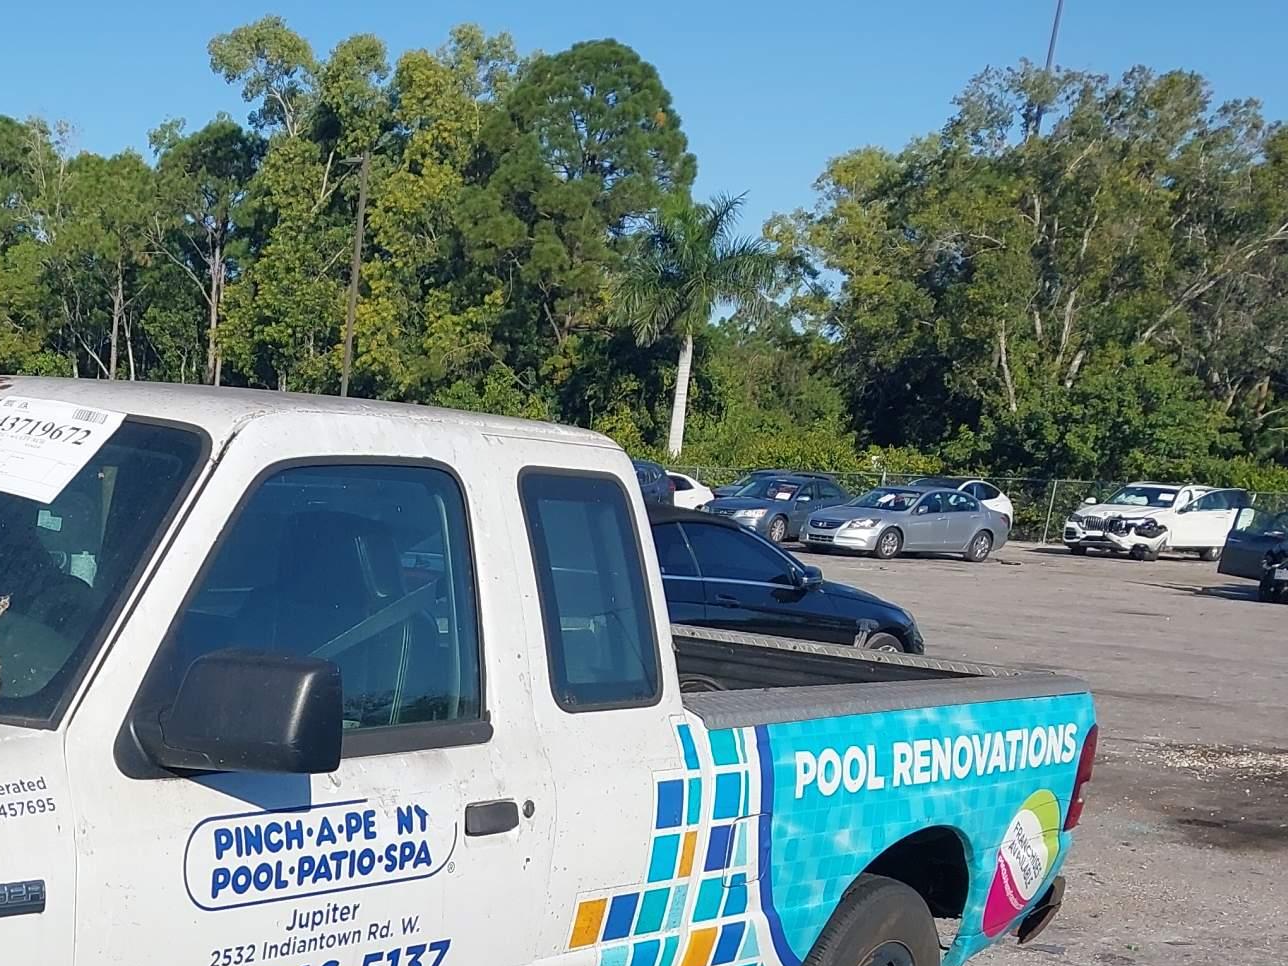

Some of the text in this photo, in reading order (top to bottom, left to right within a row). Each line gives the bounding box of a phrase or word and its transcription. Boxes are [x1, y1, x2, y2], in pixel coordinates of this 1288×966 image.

[794, 722, 1079, 800] POOL RENOVATIONS
[1007, 839, 1034, 890] AVAILABLE
[261, 929, 362, 961] Indiantown
[367, 919, 394, 941] Rd.
[401, 915, 421, 934] W.
[285, 902, 361, 932] Jupiter
